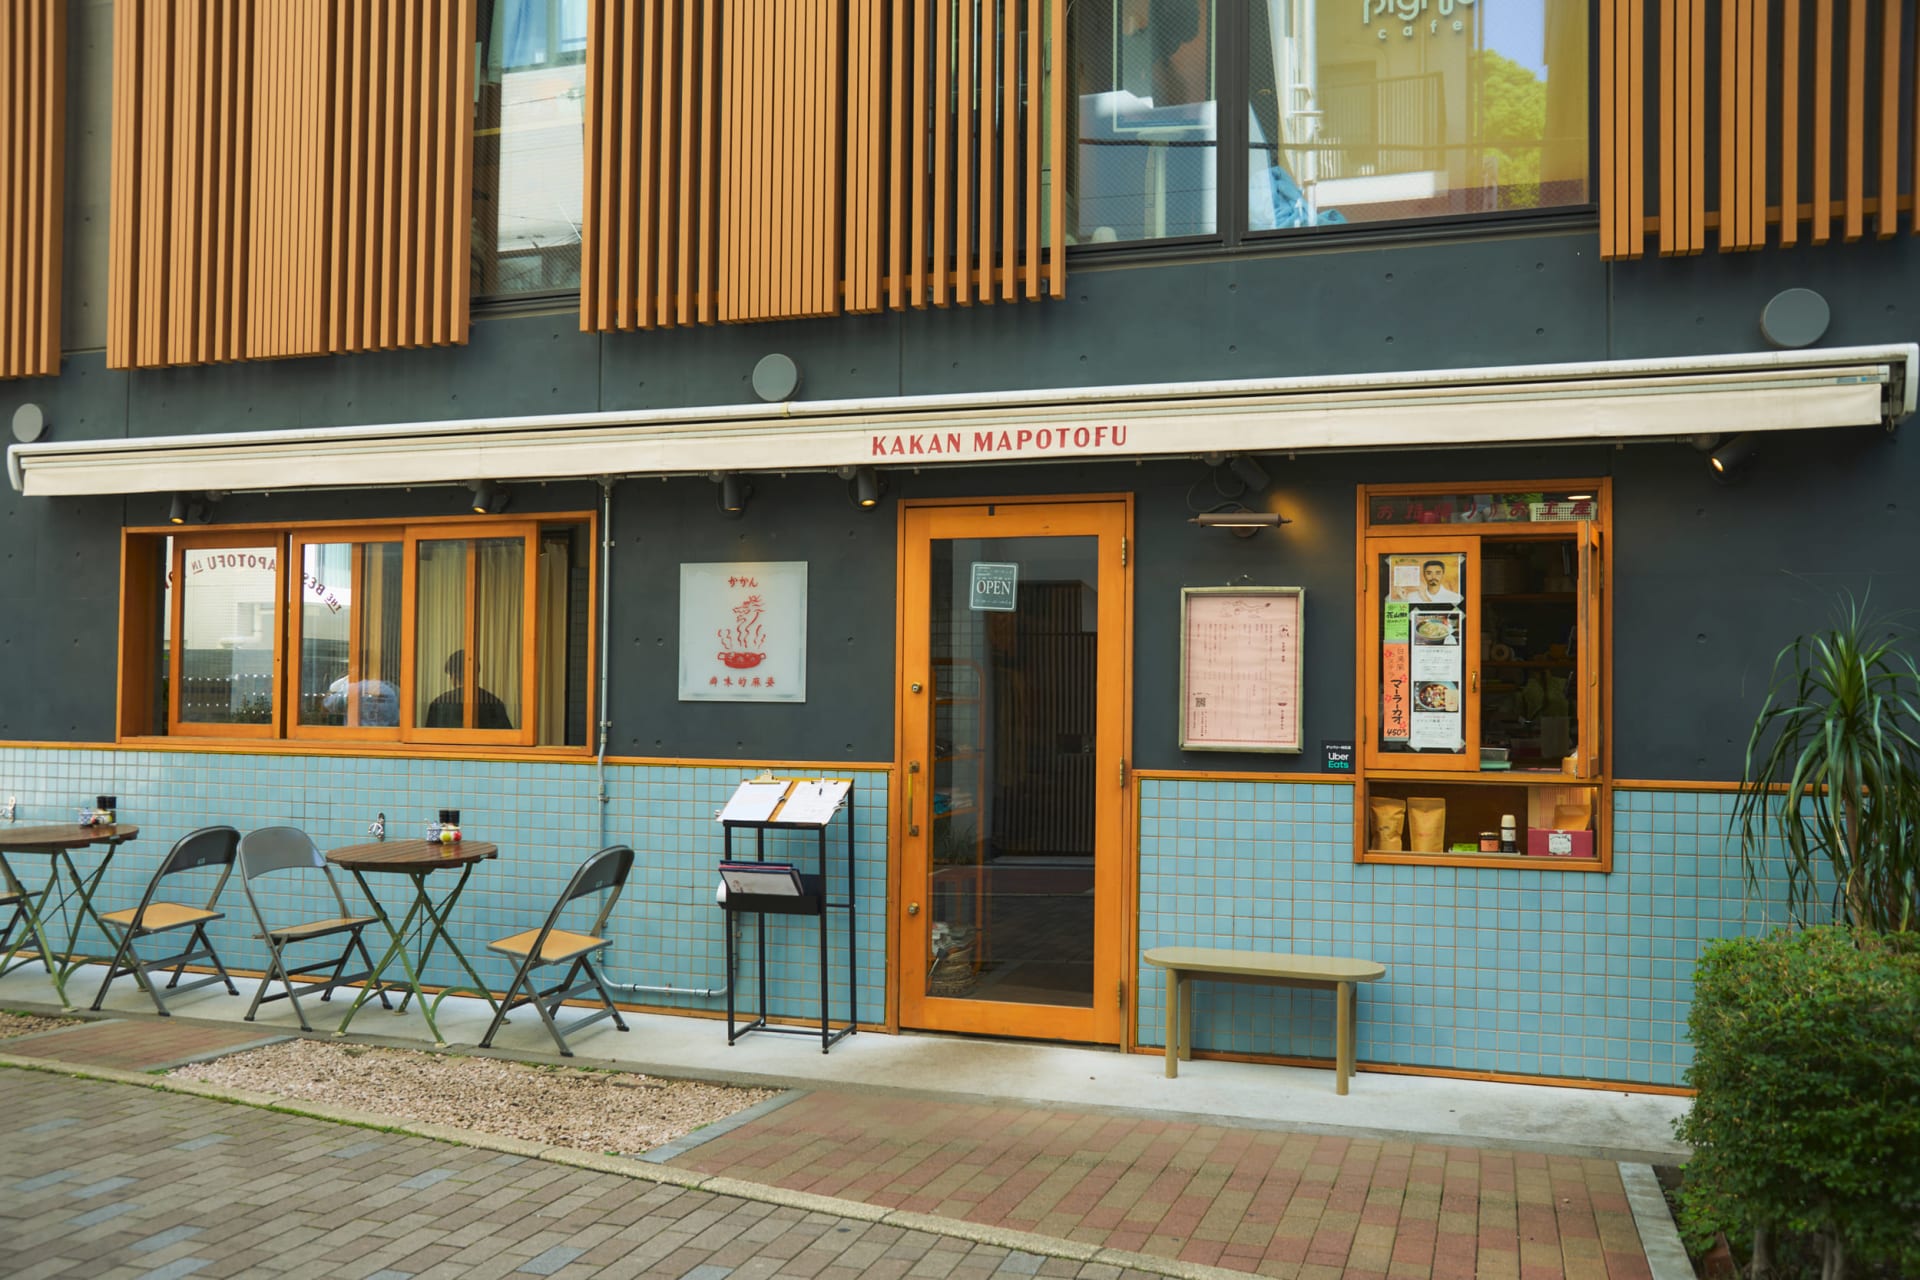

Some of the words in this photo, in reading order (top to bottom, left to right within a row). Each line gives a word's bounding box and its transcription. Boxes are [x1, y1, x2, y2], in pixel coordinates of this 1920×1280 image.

[1378, 19, 1463, 39] cafe
[872, 433, 961, 456] KAKAN
[973, 425, 1127, 452] MAPOTOFU
[728, 576, 758, 588] かかん
[976, 579, 1012, 595] OPEN
[1328, 752, 1349, 760] Uber
[1328, 760, 1349, 769] Eats
